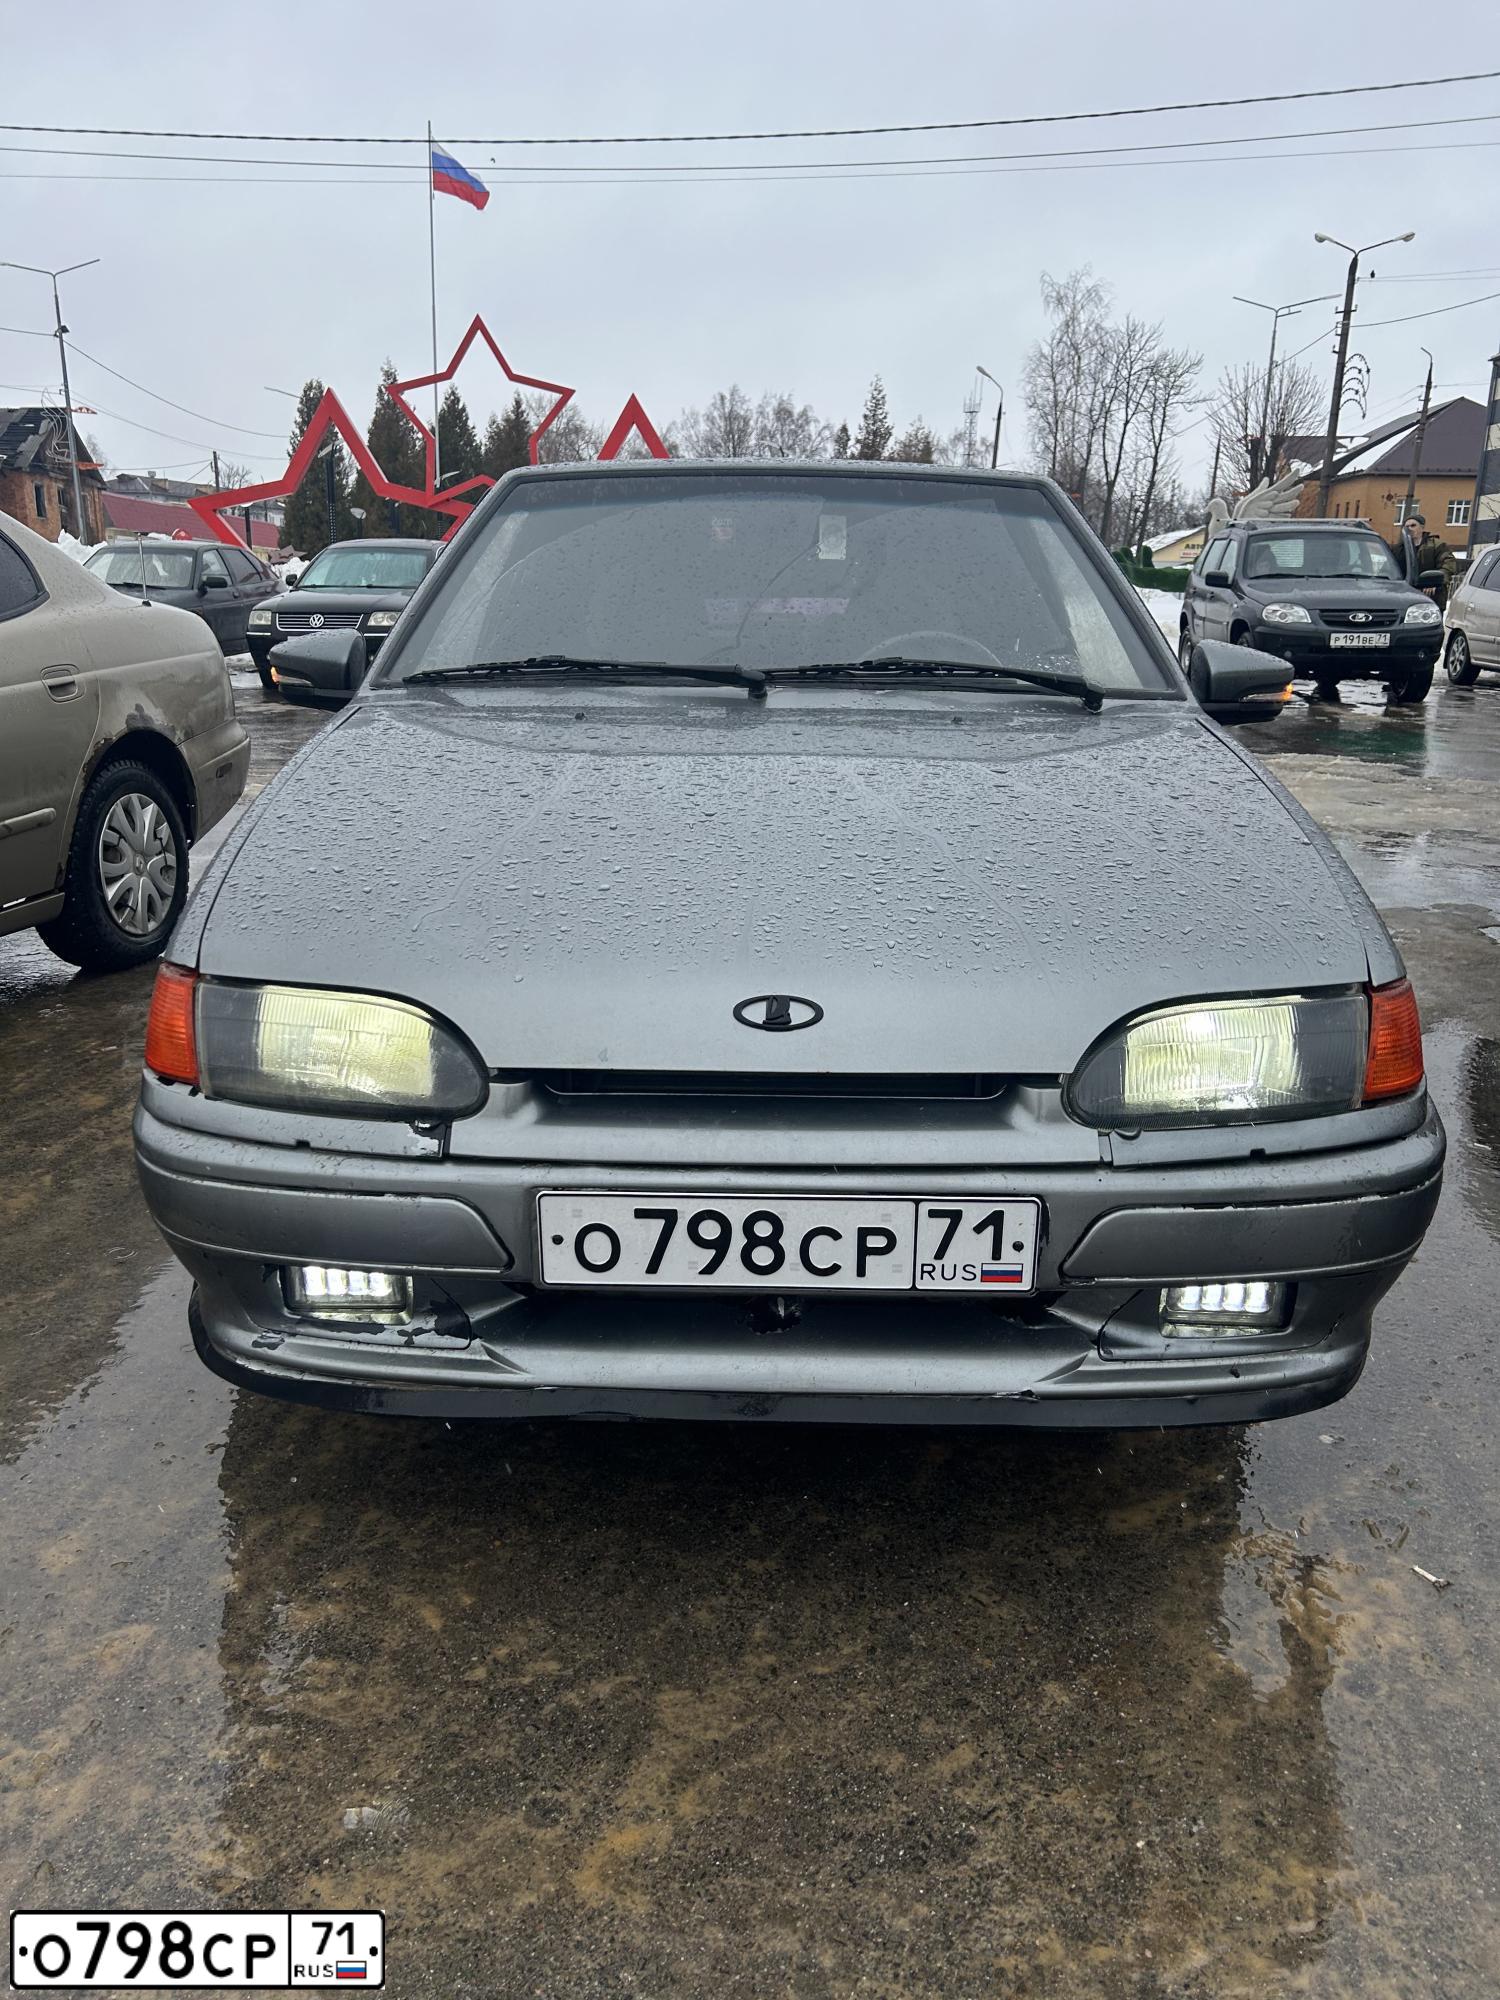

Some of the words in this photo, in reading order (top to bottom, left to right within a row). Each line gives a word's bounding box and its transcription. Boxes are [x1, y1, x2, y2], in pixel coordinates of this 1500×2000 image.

[1334, 634, 1375, 645] Р191ВЕ
[574, 1207, 898, 1278] О798СР
[927, 1208, 1005, 1262] 71
[920, 1263, 977, 1282] RUS
